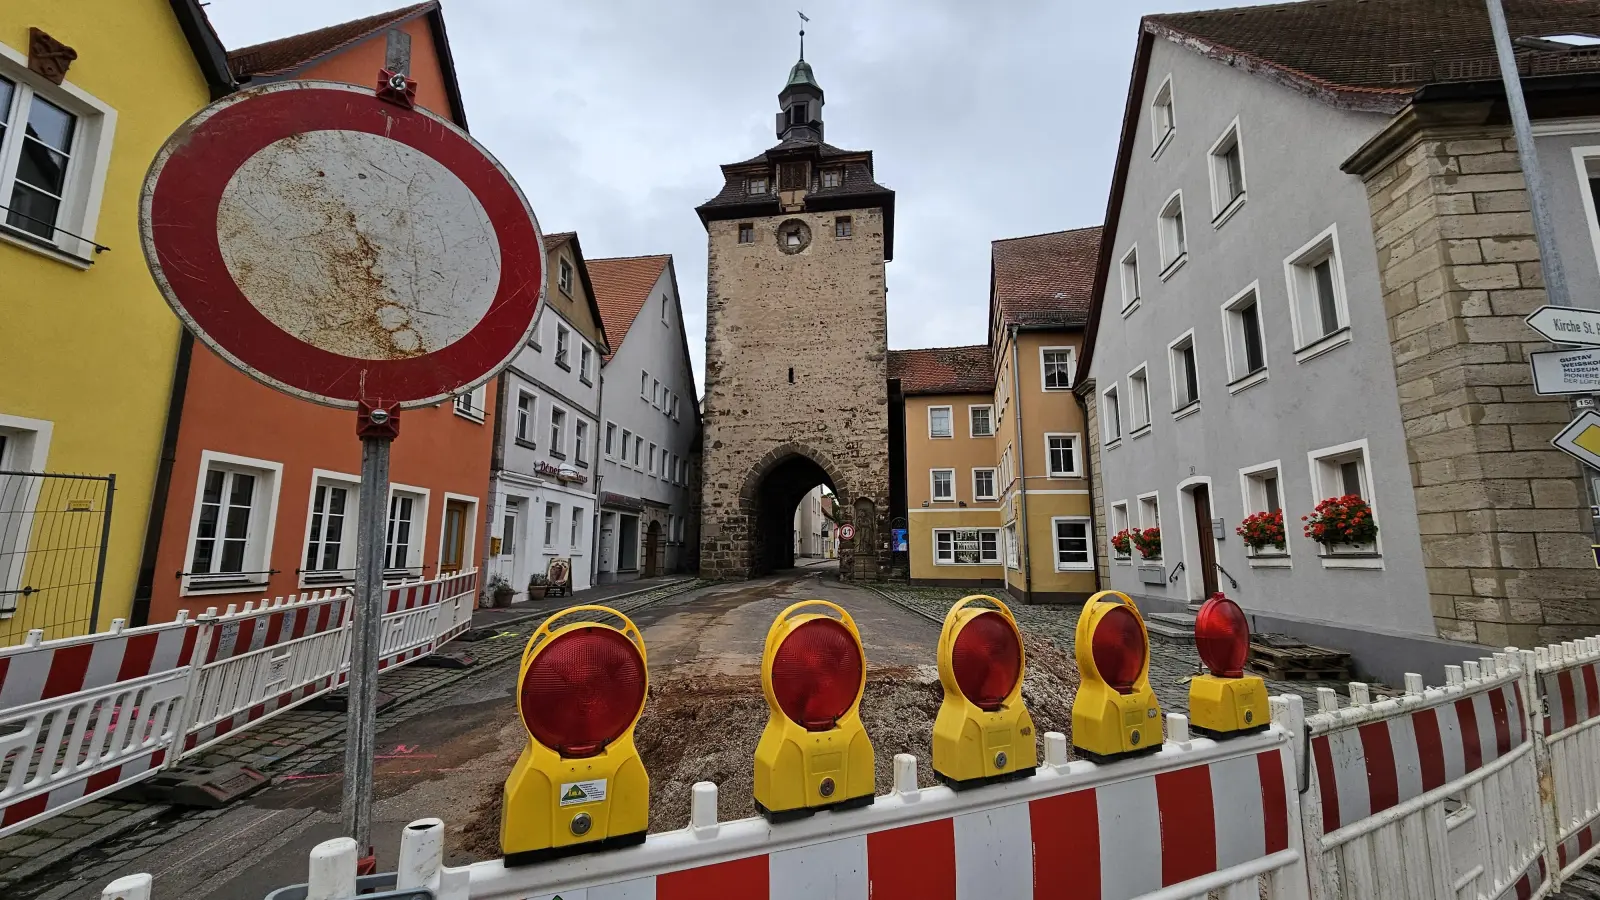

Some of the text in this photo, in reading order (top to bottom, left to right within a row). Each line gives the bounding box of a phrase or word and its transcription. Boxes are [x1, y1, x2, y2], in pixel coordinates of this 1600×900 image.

[1553, 318, 1581, 333] Kirche
[1583, 321, 1595, 335] St.
[1560, 354, 1592, 363] GUSTAV
